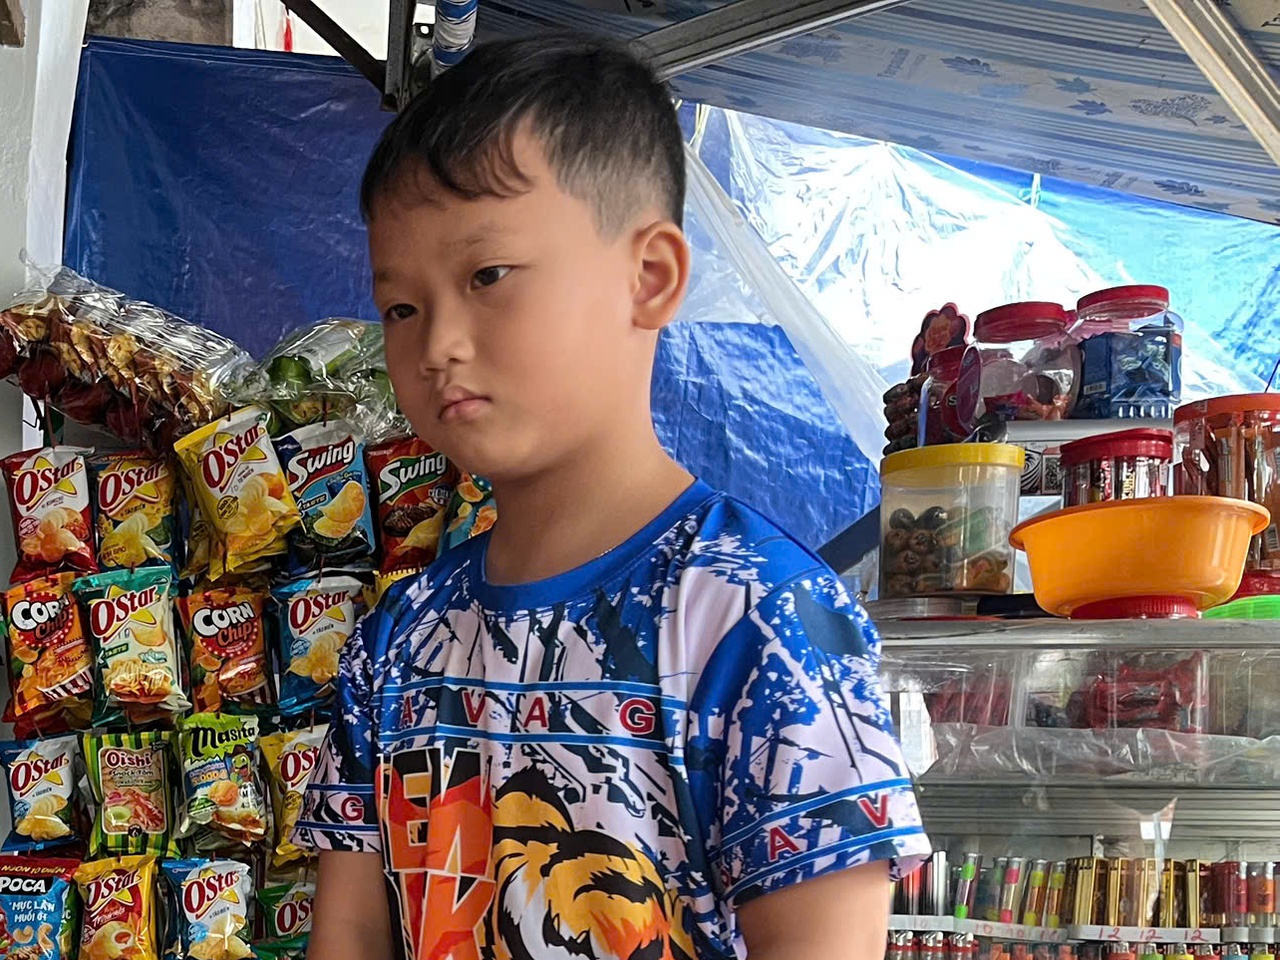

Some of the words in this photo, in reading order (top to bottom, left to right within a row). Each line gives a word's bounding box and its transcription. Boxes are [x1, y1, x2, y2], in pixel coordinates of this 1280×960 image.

[202, 422, 261, 489] O'Star
[287, 435, 357, 490] Swing
[15, 457, 78, 507] O'Star
[100, 461, 165, 511] O'Star
[379, 452, 450, 503] Swing
[91, 586, 158, 638] O'Star
[193, 601, 255, 636] CORN
[290, 589, 349, 632] O'Star
[215, 620, 253, 648] Chip
[106, 752, 152, 768] Oishi
[190, 727, 256, 758] Masita
[11, 751, 69, 794] O'Star
[280, 746, 320, 788] O'St
[1099, 927, 1119, 941] 12
[1140, 927, 1157, 941] 12
[1184, 928, 1206, 942] 12
